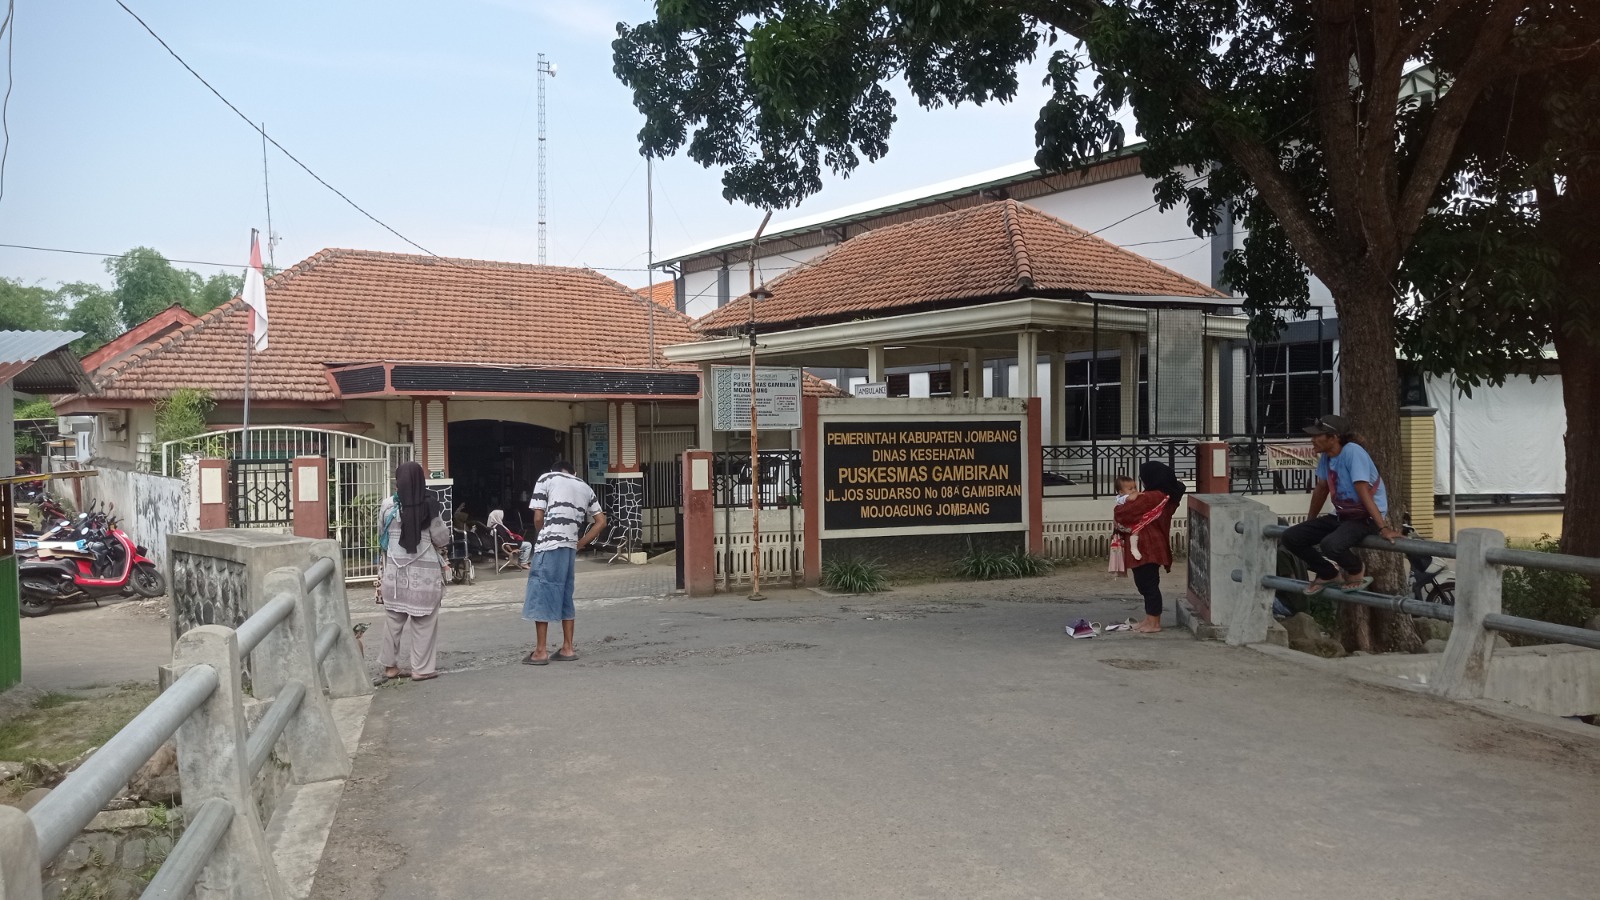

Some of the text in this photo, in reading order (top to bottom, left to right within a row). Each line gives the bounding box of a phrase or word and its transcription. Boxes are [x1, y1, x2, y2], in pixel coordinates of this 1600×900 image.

[827, 430, 1017, 445] PEMERINTAH KABUPATEN JOMBANG
[872, 448, 975, 462] DINAS KESEHATAN
[838, 465, 1009, 484] PUSKESMAS GAMBIRAN
[865, 487, 921, 500] SUDARSO
[924, 487, 938, 499] No
[961, 485, 1021, 498] GAMBIRAN
[860, 503, 990, 518] MOJOAGUNG JOMBANG
